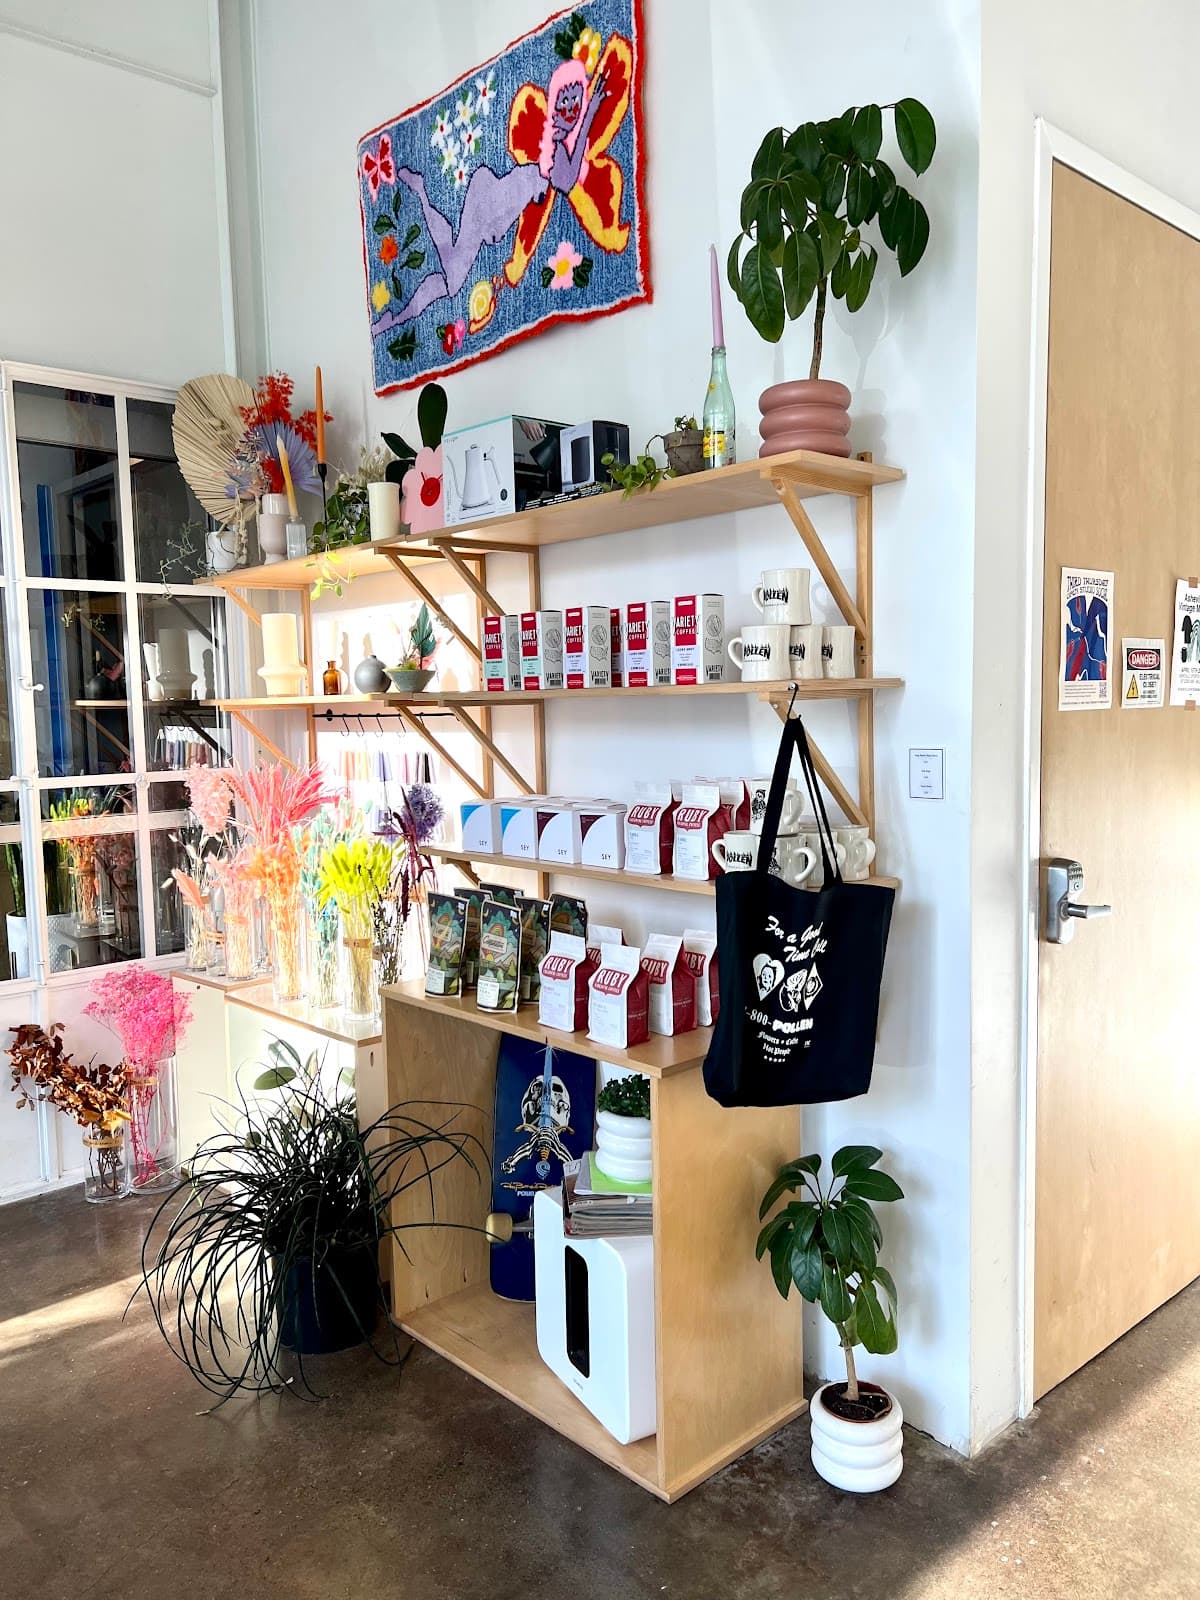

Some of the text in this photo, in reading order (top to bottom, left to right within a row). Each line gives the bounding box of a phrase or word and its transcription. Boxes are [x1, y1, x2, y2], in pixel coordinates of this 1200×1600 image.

[1131, 653, 1158, 665] DANGER
[655, 667, 671, 679] VARIET
[705, 664, 724, 677] VARIETY
[630, 806, 660, 820] RUBY
[677, 809, 708, 822] RUBY
[765, 915, 784, 939] For
[787, 934, 797, 943] a
[783, 946, 810, 963] Time
[544, 956, 575, 974] RUBY
[597, 969, 629, 988] RUBY
